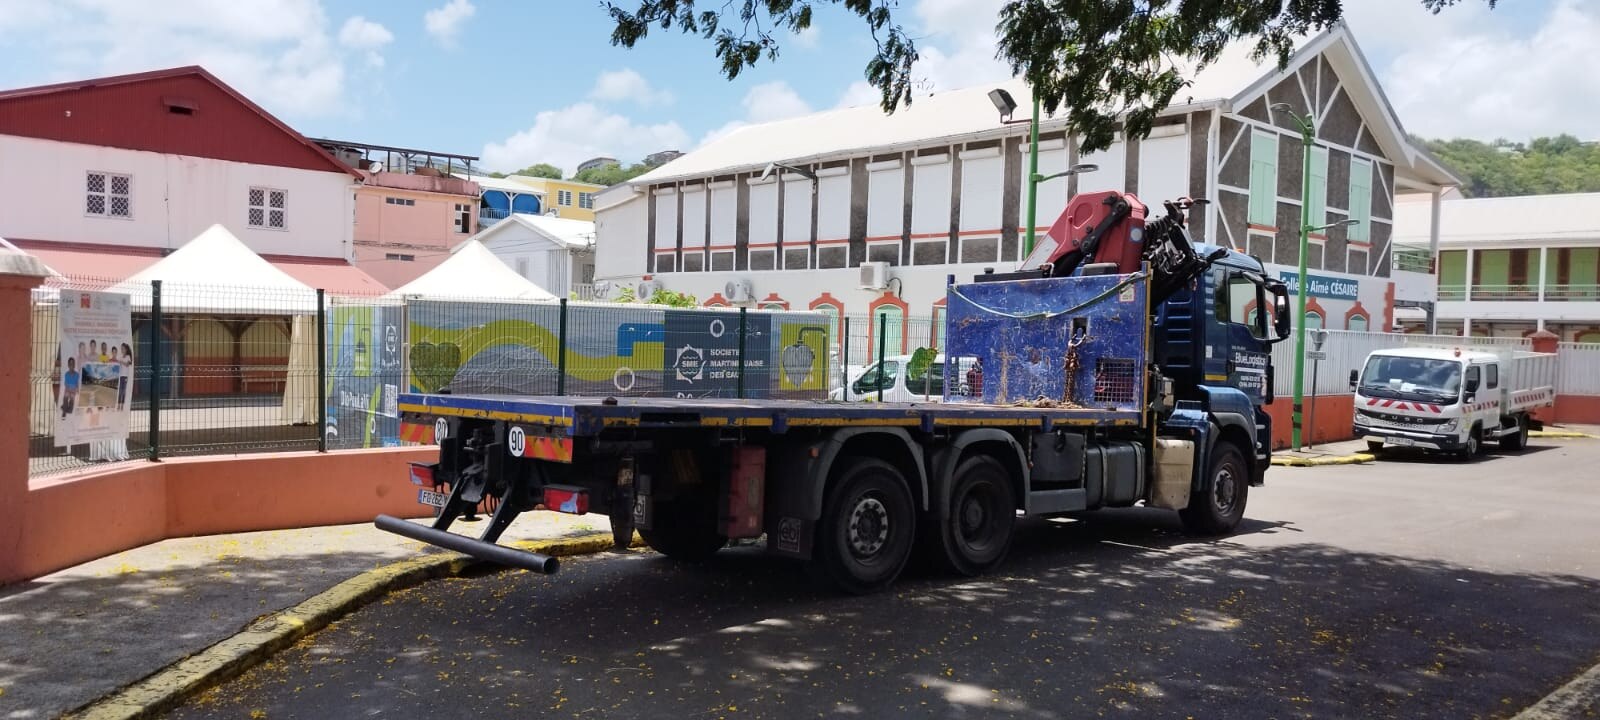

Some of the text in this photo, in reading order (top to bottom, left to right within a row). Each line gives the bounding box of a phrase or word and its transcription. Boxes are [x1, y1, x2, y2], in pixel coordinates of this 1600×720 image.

[1281, 276, 1357, 296] Collèe Aimé CÉSAIRE
[681, 360, 698, 368] SME
[511, 430, 523, 452] 90
